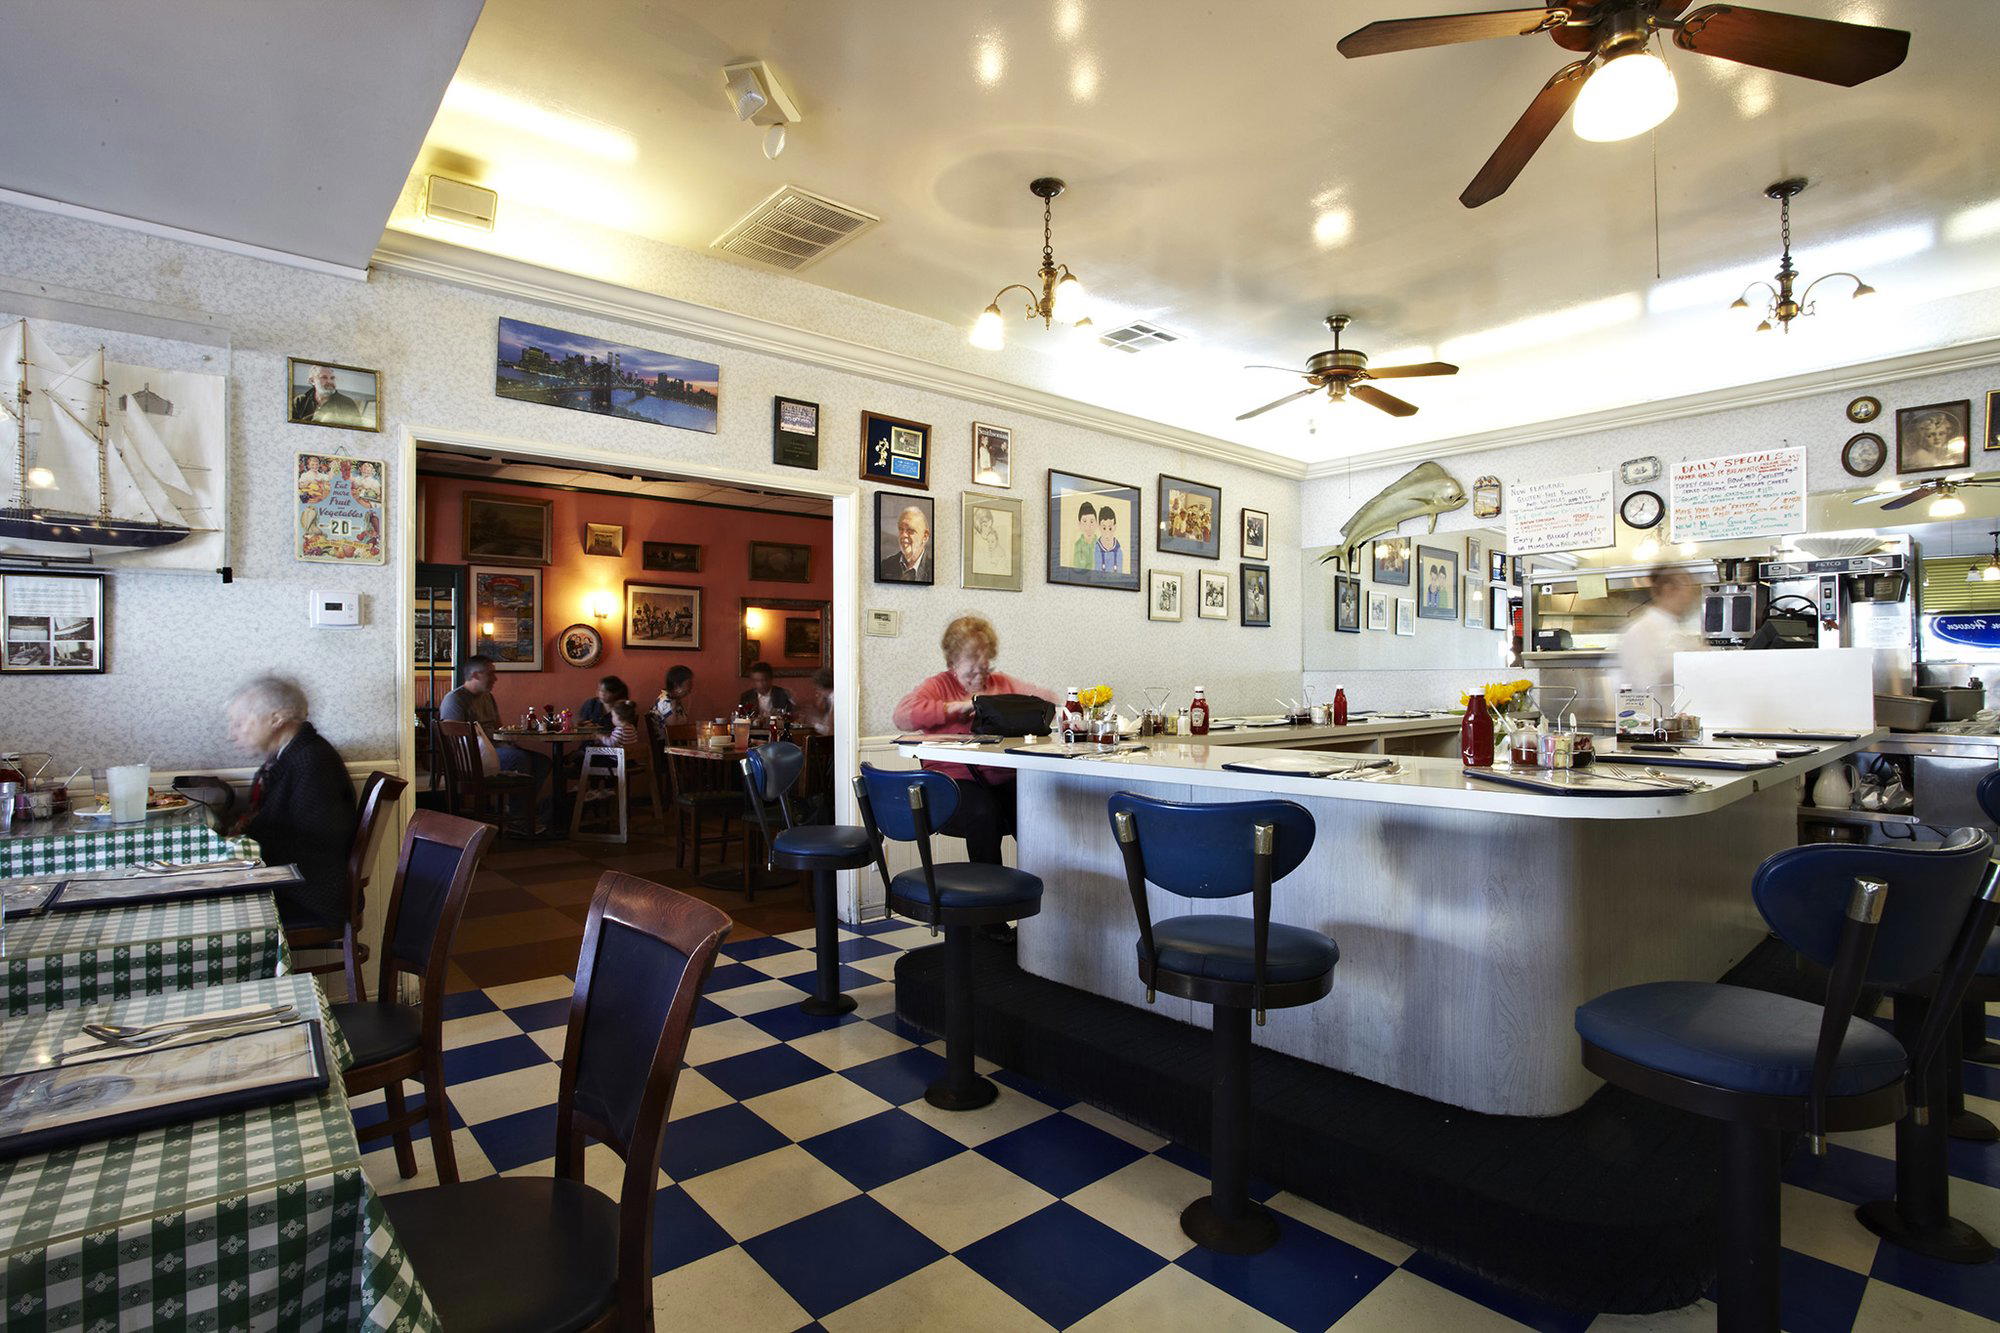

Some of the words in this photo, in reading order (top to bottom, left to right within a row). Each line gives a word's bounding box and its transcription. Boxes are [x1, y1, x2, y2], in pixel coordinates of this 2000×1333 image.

[978, 429, 1008, 439] Smithsonian
[1682, 461, 1717, 474] DAILY
[1724, 453, 1783, 467] SPECIALS
[334, 480, 348, 490] Eat
[329, 496, 351, 507] Fruit
[319, 507, 363, 519] Vegetables
[332, 520, 349, 535] 20
[1513, 536, 1533, 544] ENJOY
[1573, 529, 1594, 538] MARY
[1528, 542, 1555, 550] MIMOSA
[1815, 561, 1842, 570] FETCO
